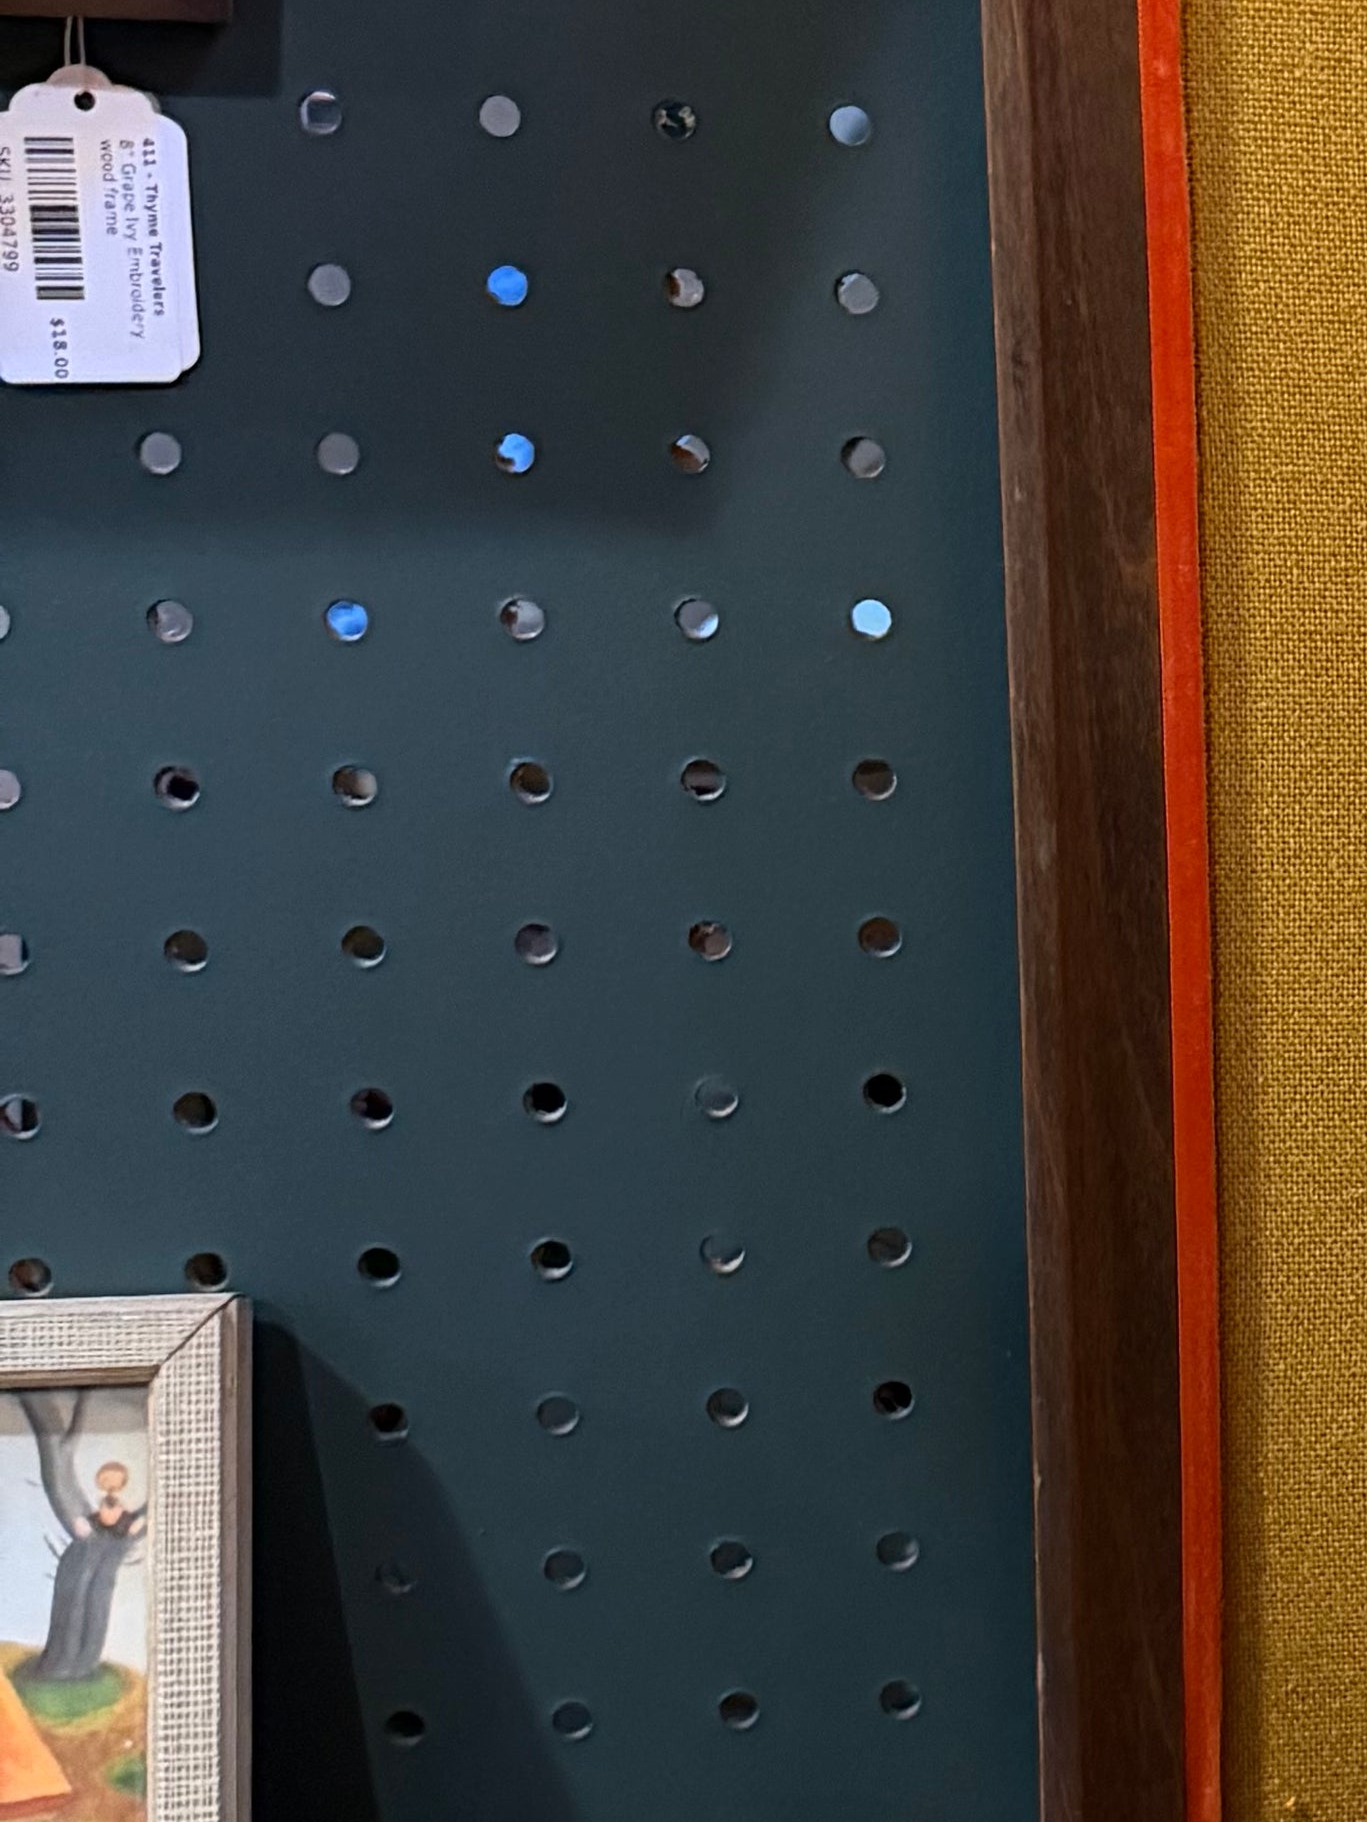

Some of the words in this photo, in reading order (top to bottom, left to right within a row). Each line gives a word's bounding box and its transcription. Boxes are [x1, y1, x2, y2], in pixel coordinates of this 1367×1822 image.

[100, 139, 118, 182] wood
[142, 138, 157, 167] 411
[103, 188, 120, 235] frame
[120, 163, 137, 212] Grape
[143, 183, 159, 237] Thyme
[0, 194, 20, 272] 3304799
[123, 218, 140, 241] Ivy
[127, 247, 146, 339] Embroidery
[150, 242, 166, 316] Travelers
[49, 318, 70, 379] $18.00
